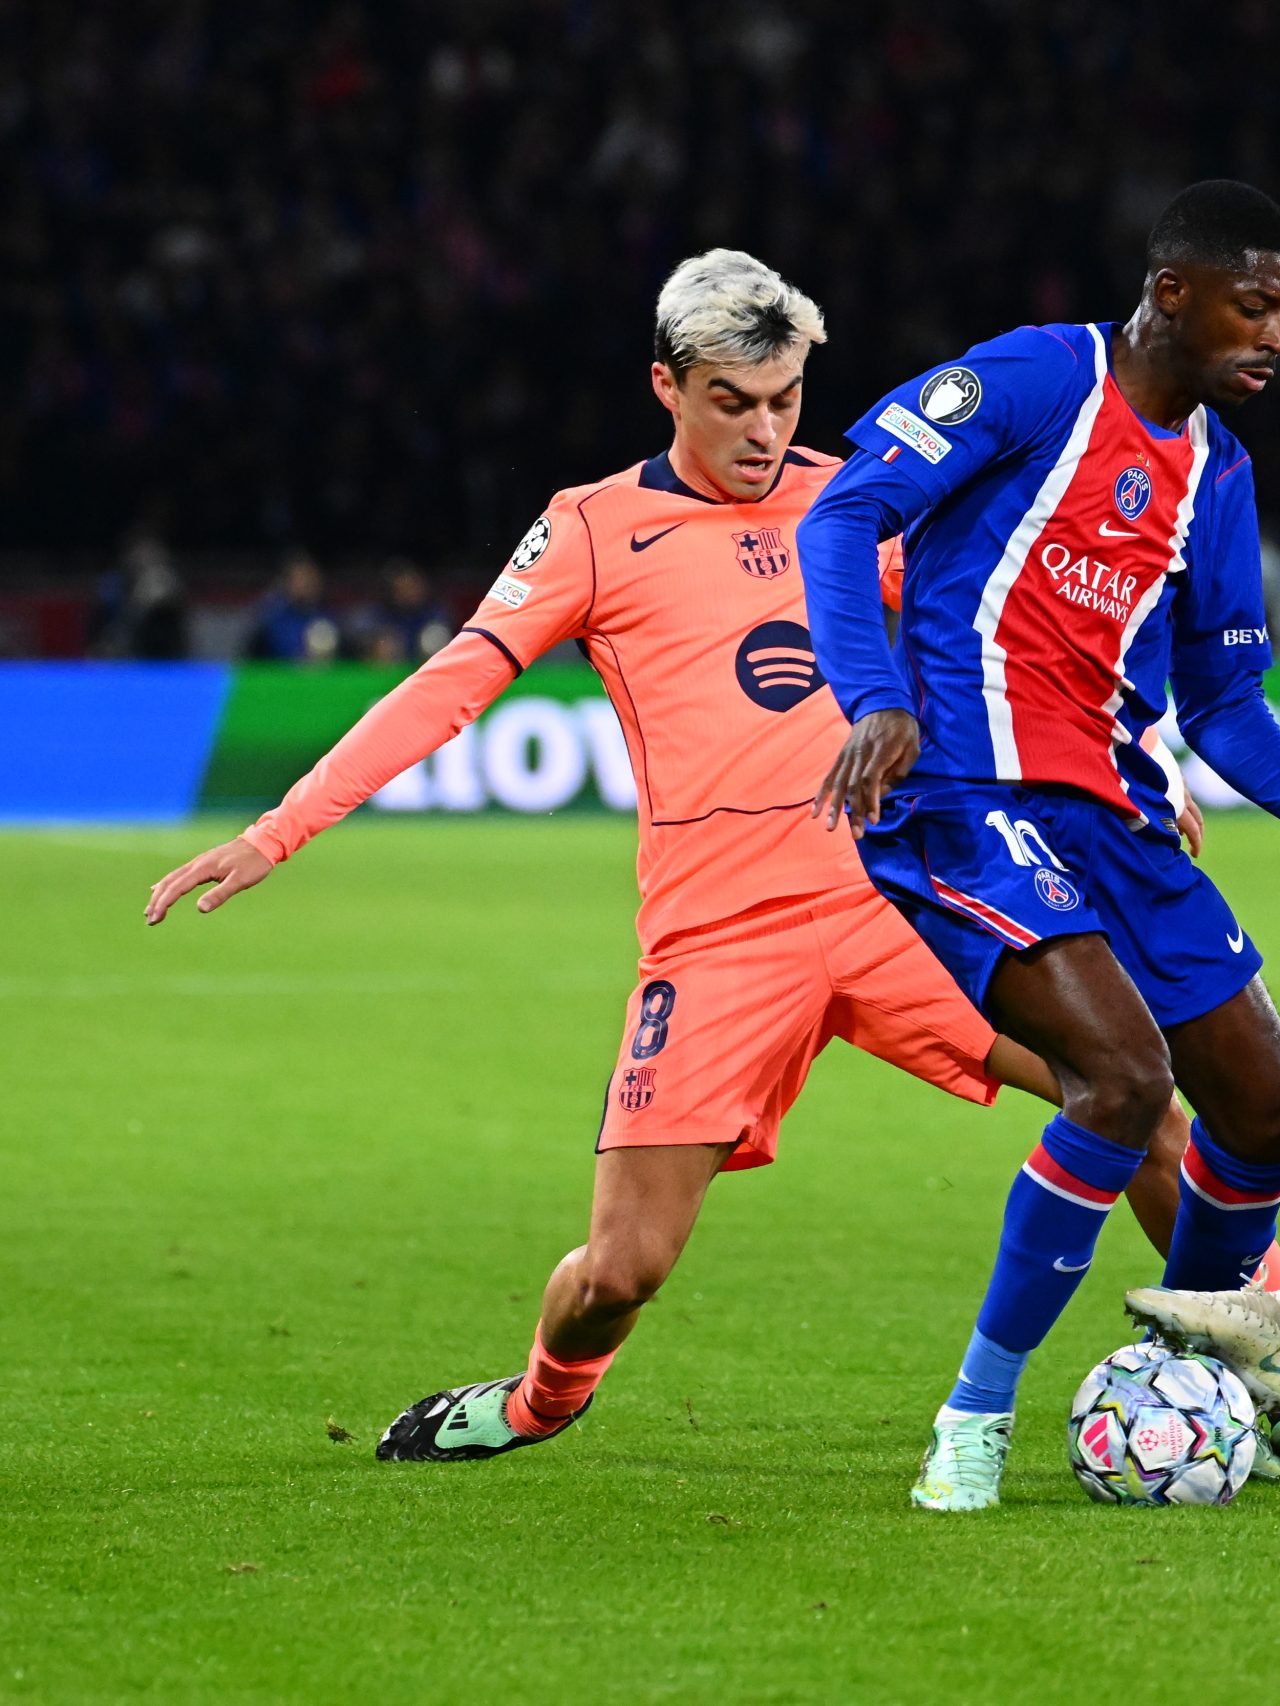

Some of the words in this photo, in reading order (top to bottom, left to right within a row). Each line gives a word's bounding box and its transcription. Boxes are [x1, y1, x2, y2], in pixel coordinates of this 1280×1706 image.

[884, 410, 945, 457] FOUNDATION
[1127, 470, 1149, 491] PARIS
[1041, 543, 1137, 605] QATAR
[1056, 581, 1129, 624] AIRWAYS
[1223, 624, 1269, 646] BEY
[985, 810, 1070, 872] 10
[632, 979, 677, 1060] 8
[1214, 1426, 1222, 1443] PRO
